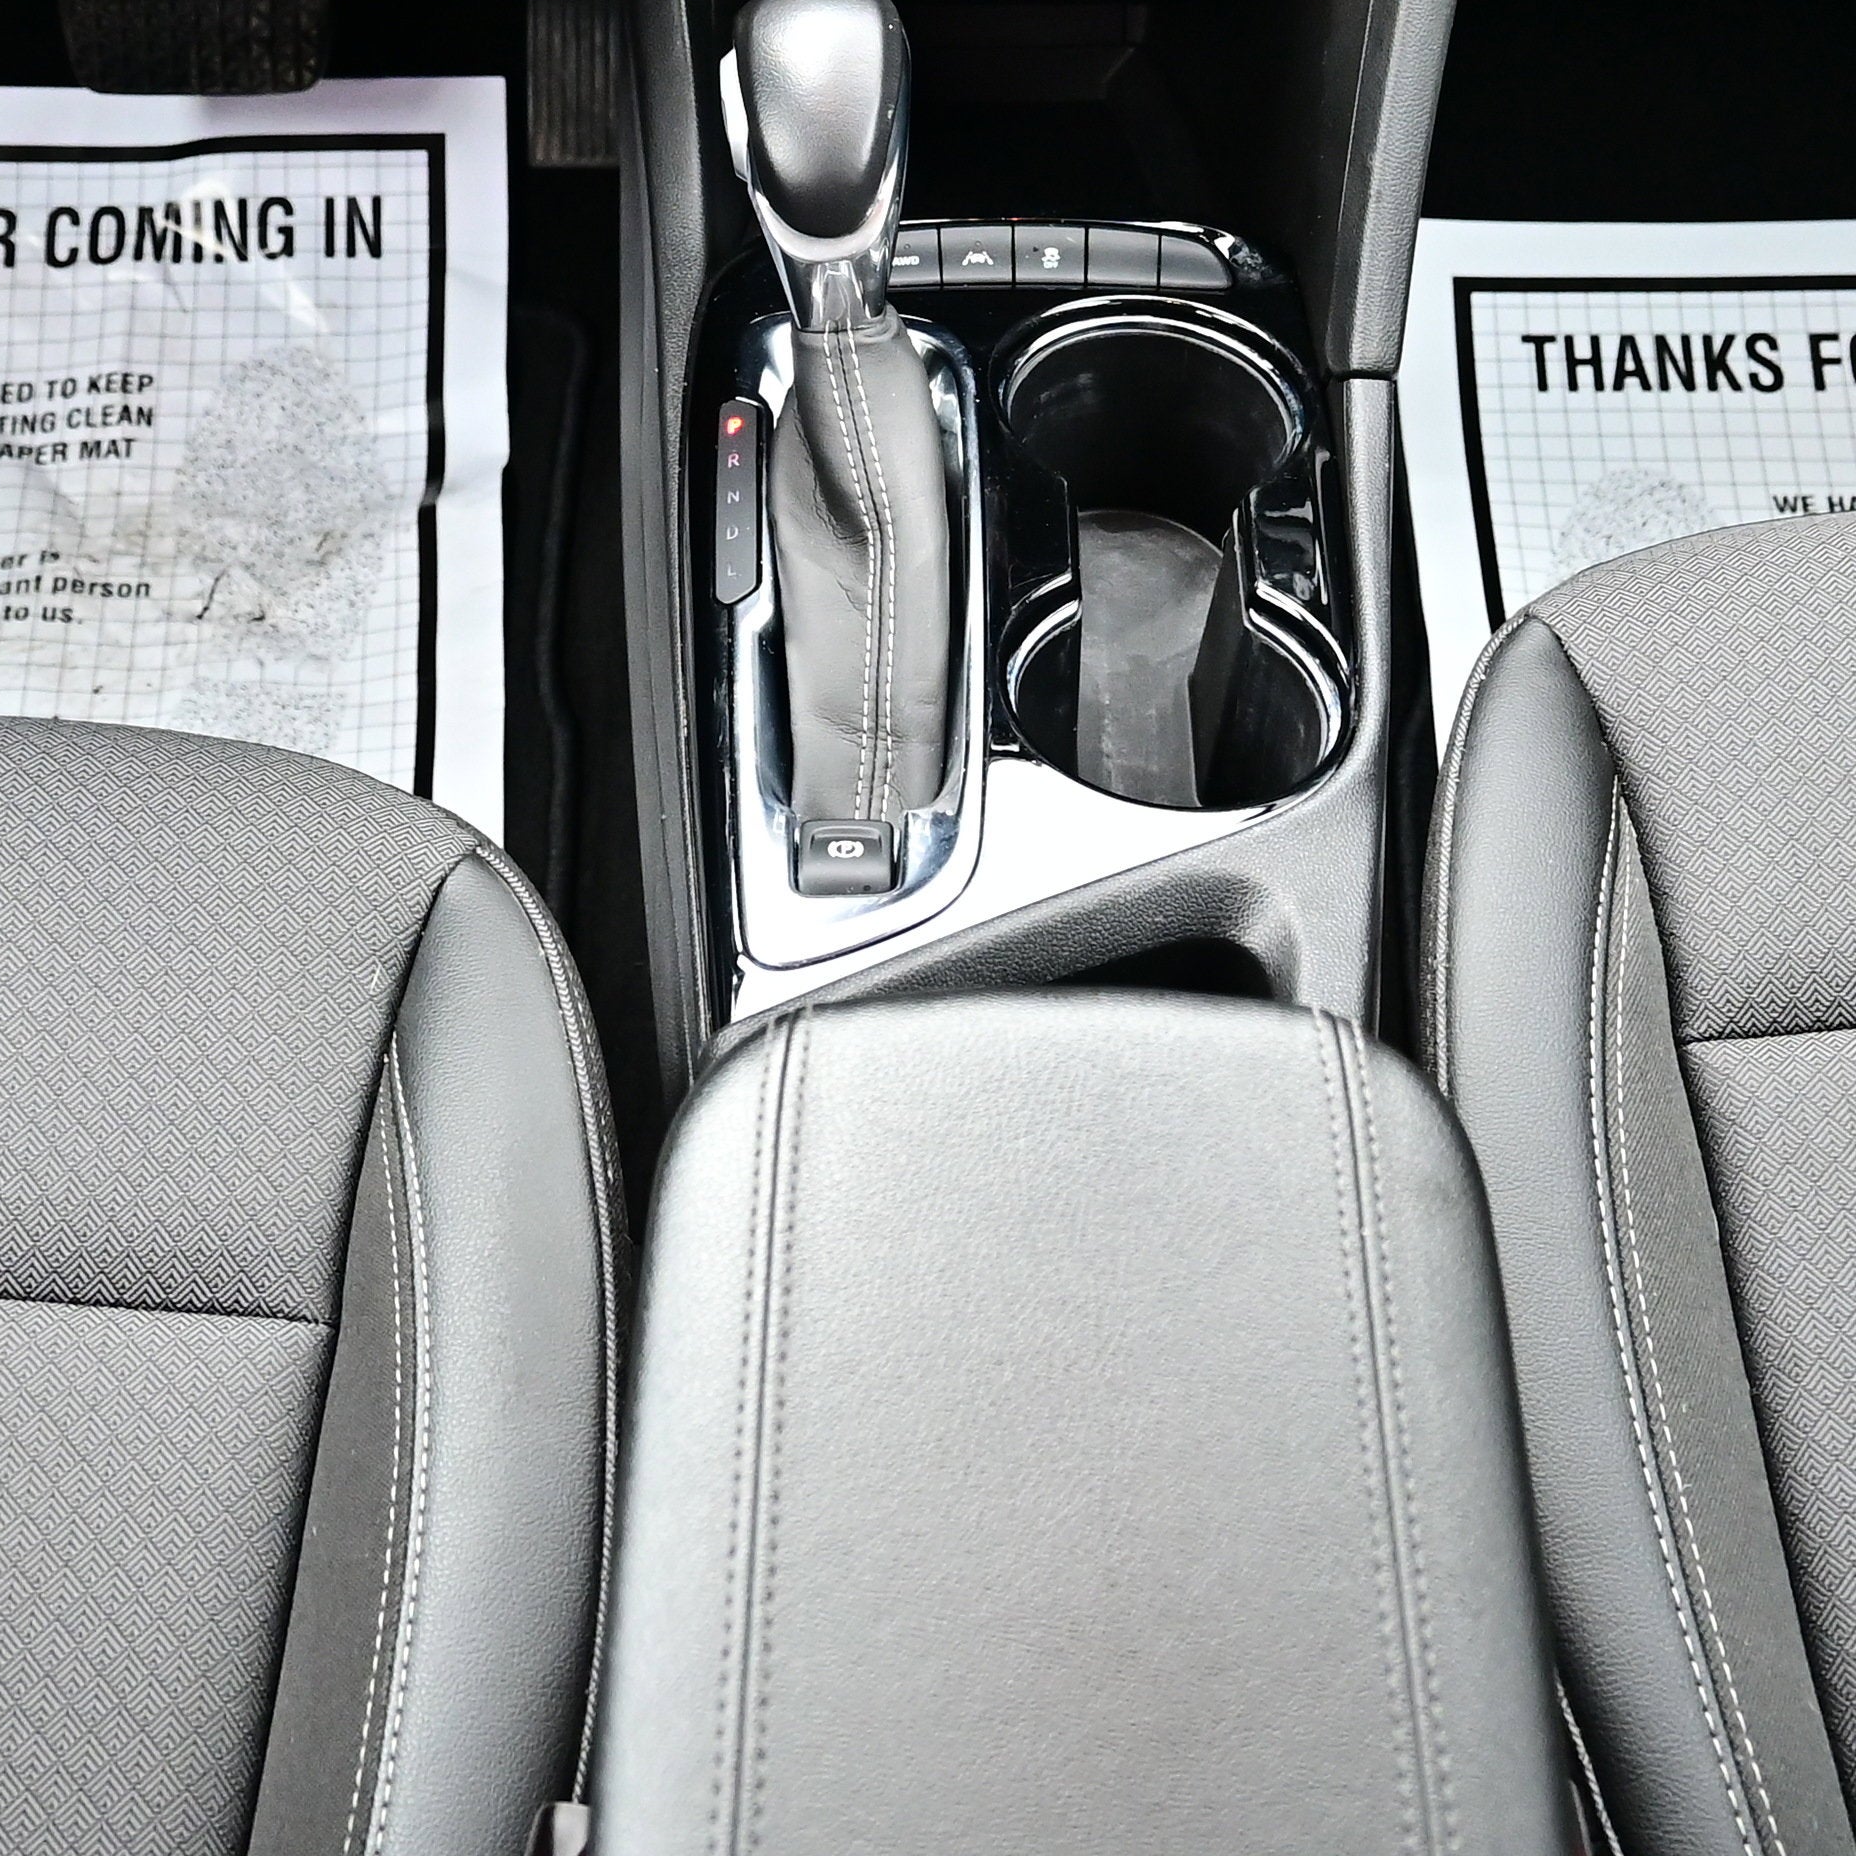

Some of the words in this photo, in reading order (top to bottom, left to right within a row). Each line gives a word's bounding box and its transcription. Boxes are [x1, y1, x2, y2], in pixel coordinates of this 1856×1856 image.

[44, 194, 296, 268] COMING
[323, 194, 384, 260] IN
[891, 255, 921, 267] AWD
[1521, 331, 1785, 394] THANKS
[46, 378, 78, 400] TO
[86, 371, 155, 395] KEEP
[66, 404, 155, 429] CLEAN
[726, 416, 743, 435] P
[78, 437, 138, 460] MAT
[727, 452, 741, 469] R
[727, 490, 741, 505] N
[1772, 494, 1815, 516] WE
[726, 526, 740, 540] D
[51, 574, 152, 599] person
[2, 605, 31, 623] to
[40, 605, 84, 626] us.
